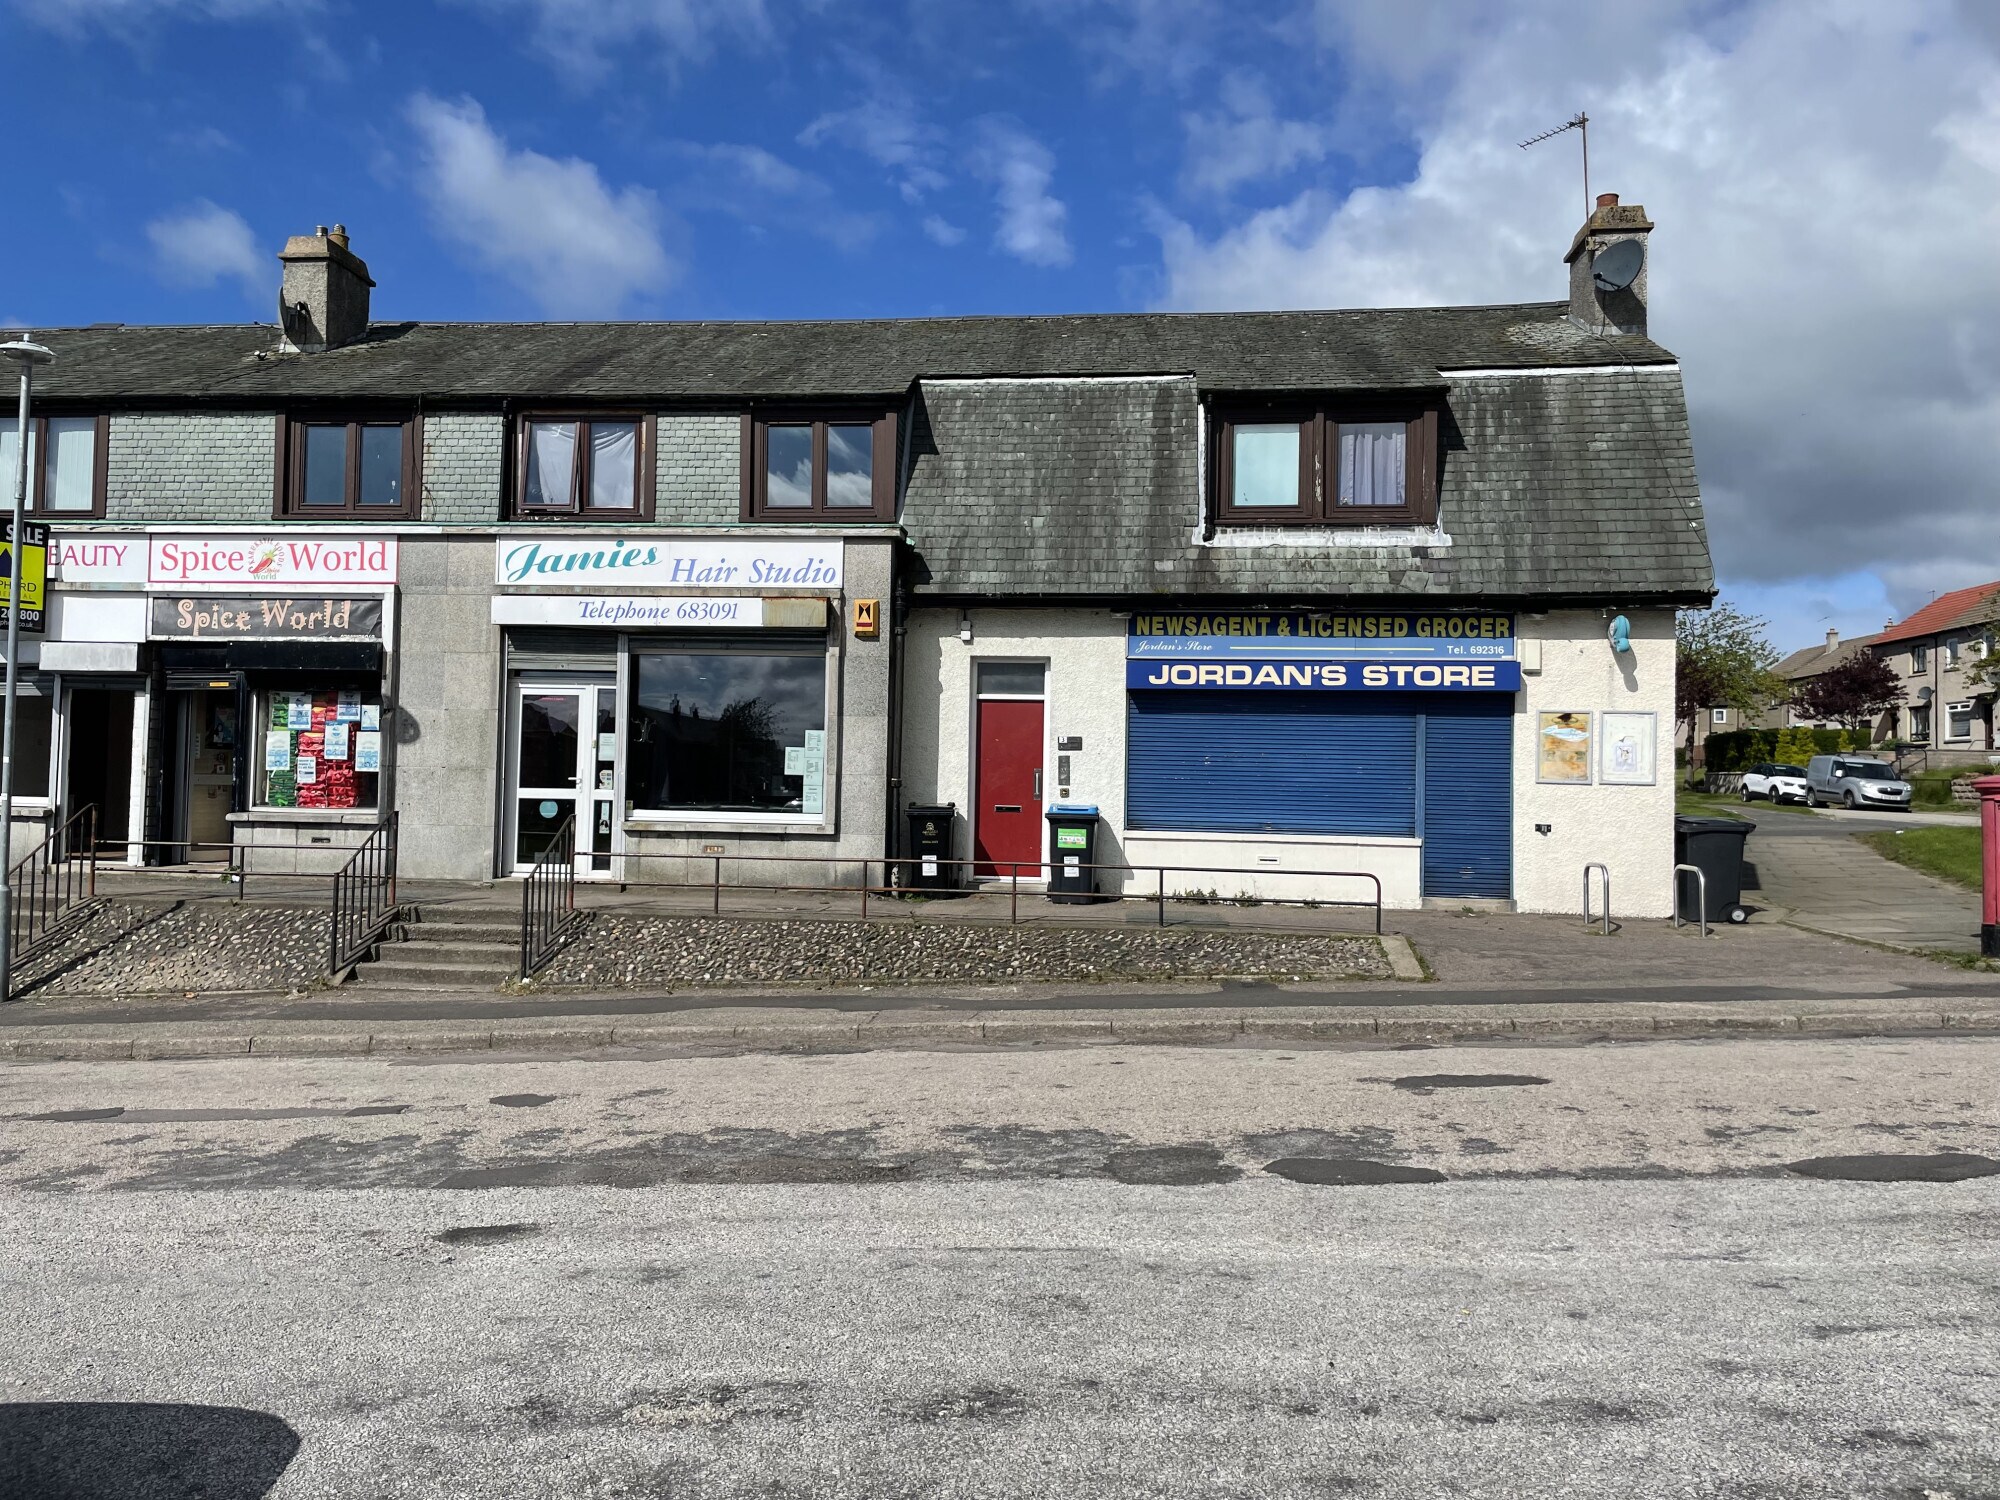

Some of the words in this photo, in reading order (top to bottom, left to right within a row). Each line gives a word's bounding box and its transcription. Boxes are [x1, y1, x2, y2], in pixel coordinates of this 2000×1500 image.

[6, 524, 43, 544] SLE
[161, 542, 244, 578] Spice
[287, 541, 388, 571] World
[505, 539, 662, 582] Jamies
[670, 558, 738, 583] Hair
[749, 558, 836, 584] Studio
[177, 599, 252, 636] Spice
[261, 599, 351, 630] World
[579, 601, 669, 623] Telephone
[677, 602, 738, 620] 683091
[1136, 616, 1270, 636] NEWSAGENT
[1277, 617, 1290, 637] &
[1298, 617, 1408, 637] LICENSED
[1416, 617, 1510, 638] GROCER
[1135, 639, 1182, 653] Jordan's
[1184, 640, 1213, 651] Store
[1447, 645, 1467, 655] Tel.
[1470, 645, 1505, 655] 692316
[1149, 664, 1347, 687] JORDAN'S
[1363, 665, 1495, 687] STORE
